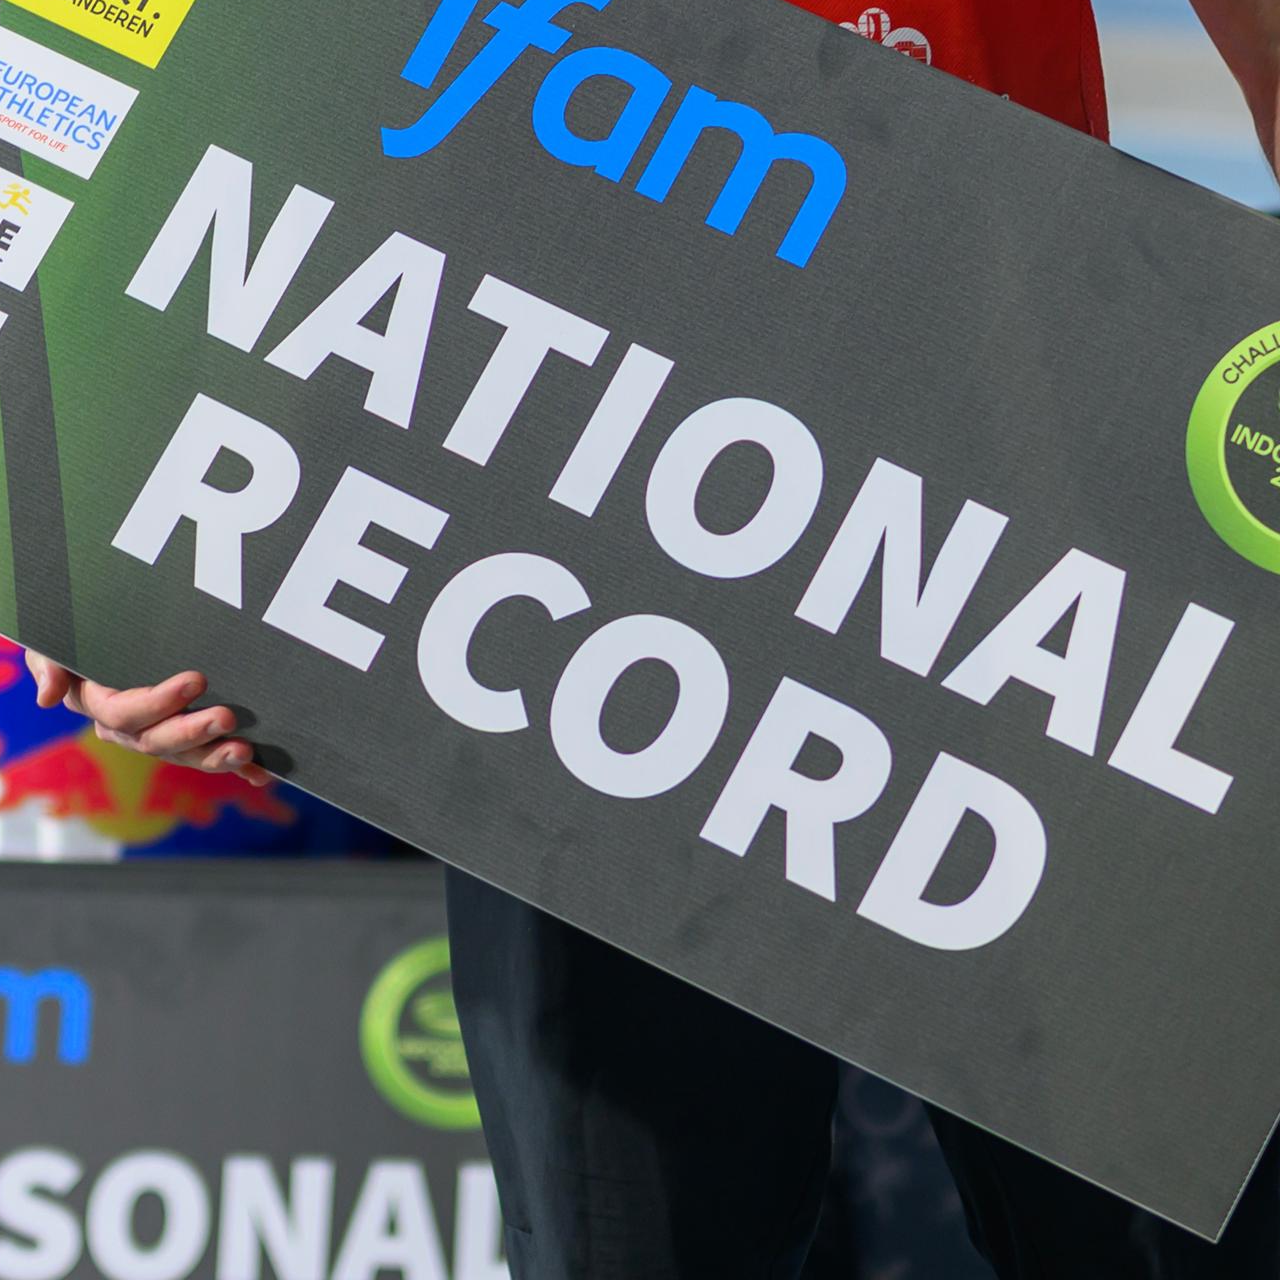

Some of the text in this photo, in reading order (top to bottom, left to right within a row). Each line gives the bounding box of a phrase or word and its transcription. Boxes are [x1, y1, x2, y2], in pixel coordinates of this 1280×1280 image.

[28, 129, 48, 143] FOR
[48, 139, 67, 152] LIFE
[111, 392, 1047, 950] RECORD
[124, 144, 1235, 814] NATIONAL
